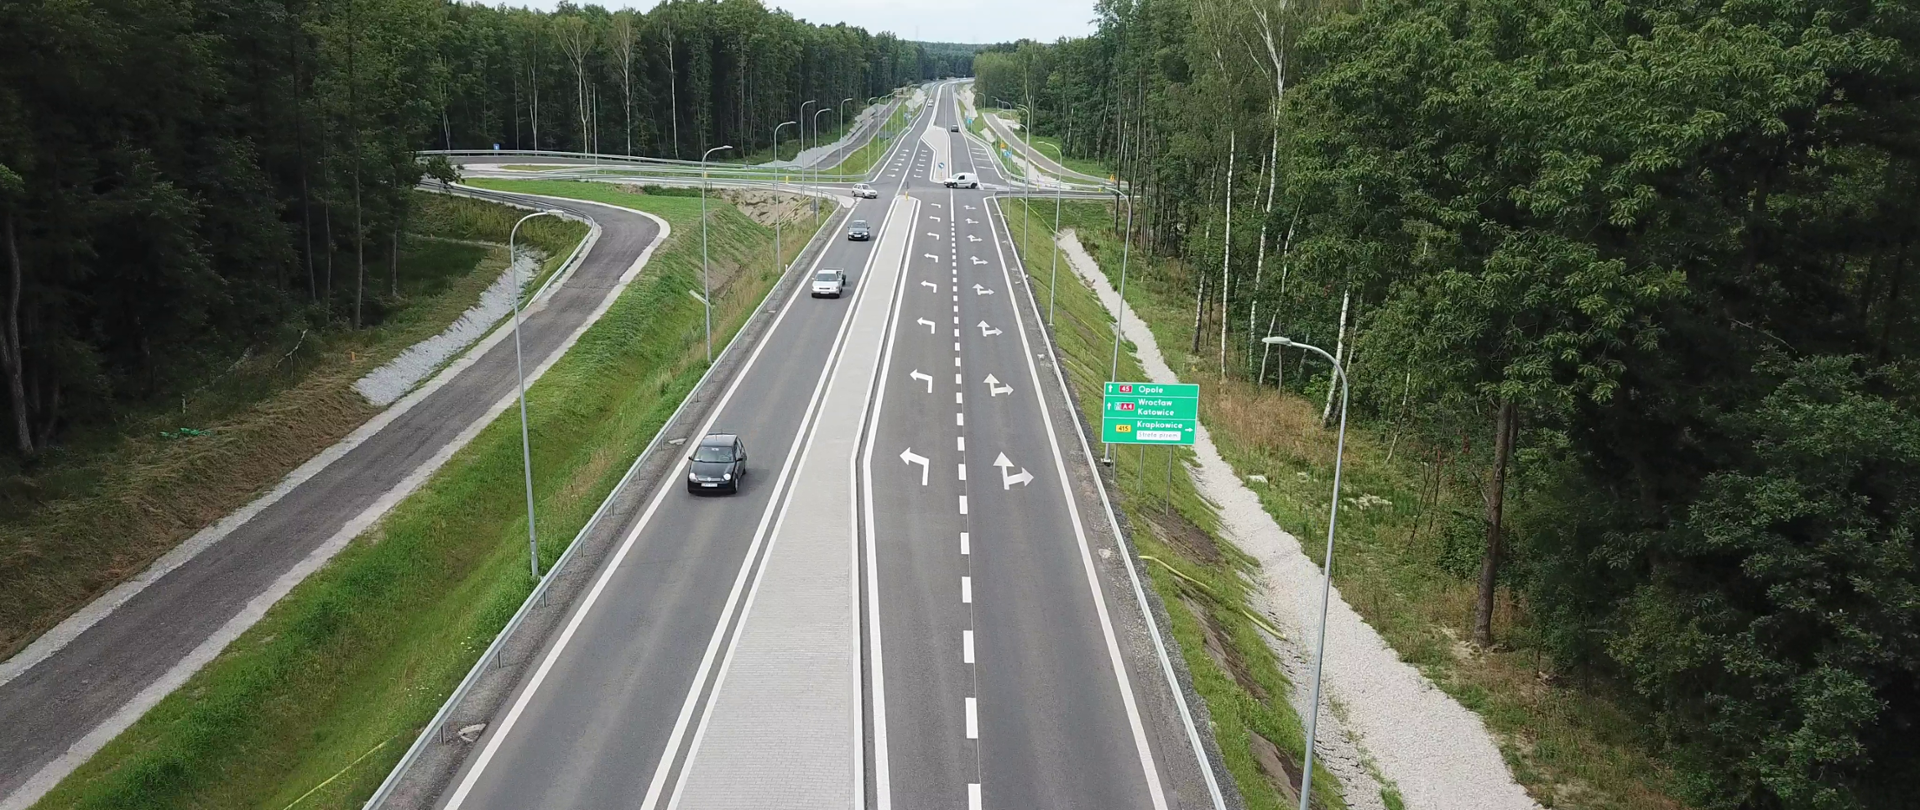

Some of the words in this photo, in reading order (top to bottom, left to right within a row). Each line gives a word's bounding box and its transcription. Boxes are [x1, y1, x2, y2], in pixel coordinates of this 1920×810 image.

[1138, 385, 1164, 394] Opole
[1138, 398, 1173, 407] Wrocław
[1137, 408, 1174, 416] Katowice
[1136, 421, 1183, 430] Krapkowice
